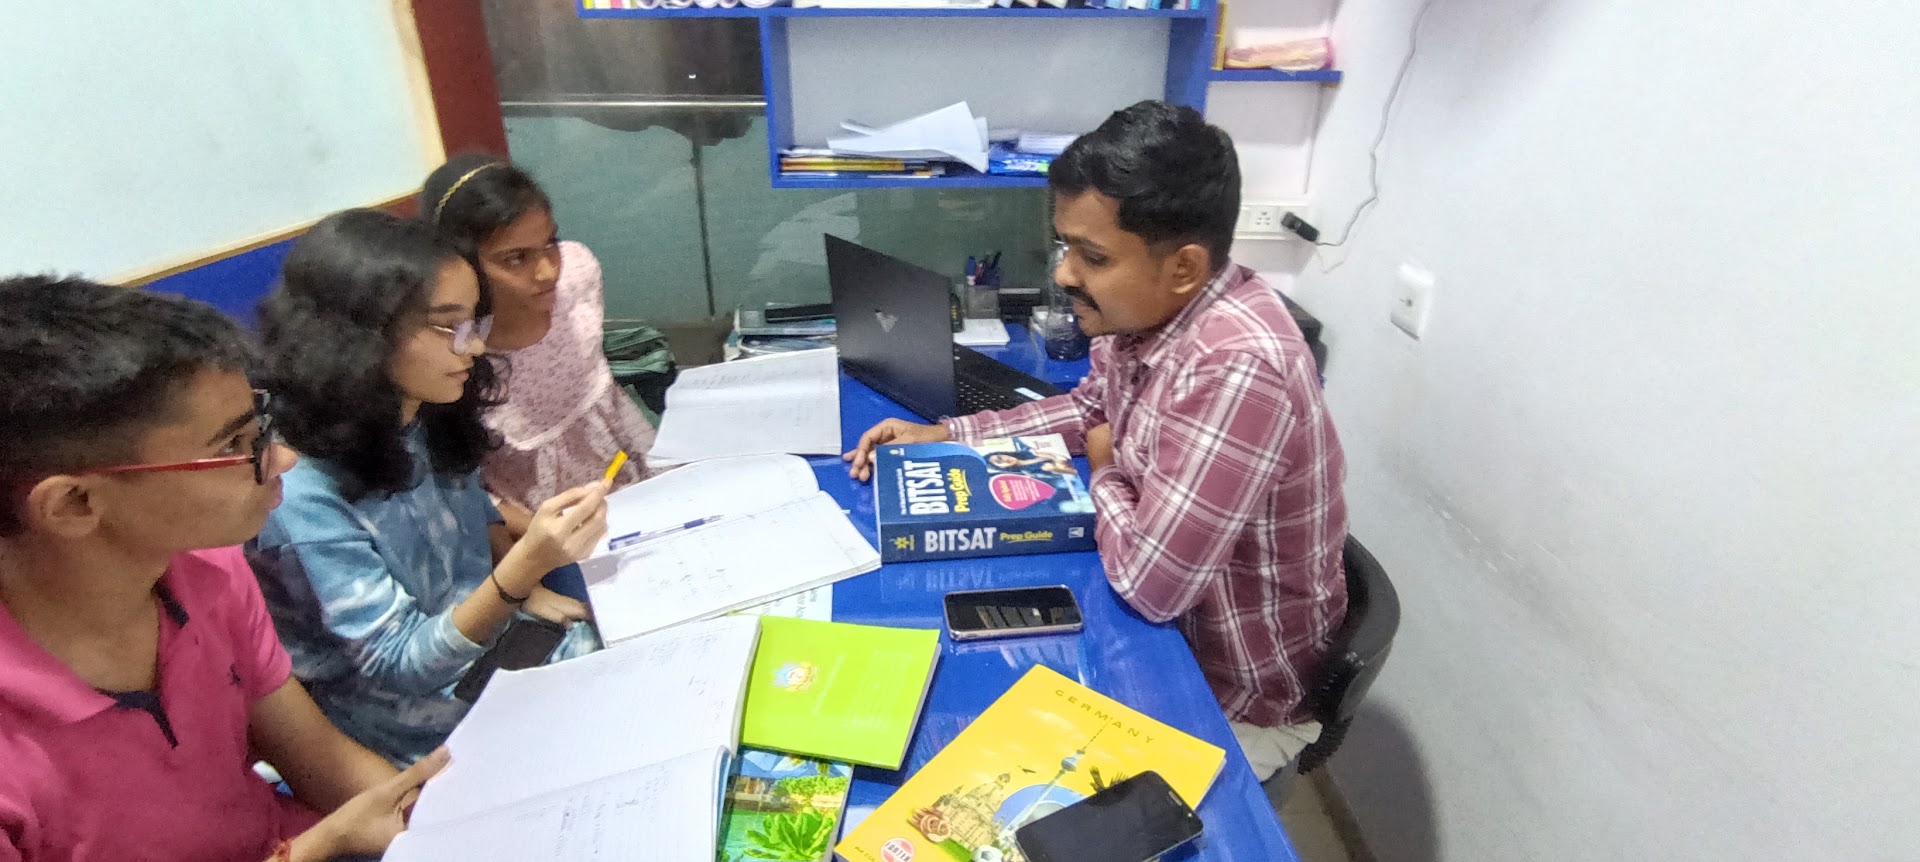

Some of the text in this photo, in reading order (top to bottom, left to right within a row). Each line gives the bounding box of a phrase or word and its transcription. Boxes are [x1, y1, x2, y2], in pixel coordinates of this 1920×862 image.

[903, 461, 949, 515] BITSAT
[947, 468, 970, 513] Prep Guide
[925, 527, 997, 553] BITSAT
[1000, 530, 1053, 542] Prep Guide
[1055, 689, 1155, 744] GERMANY
